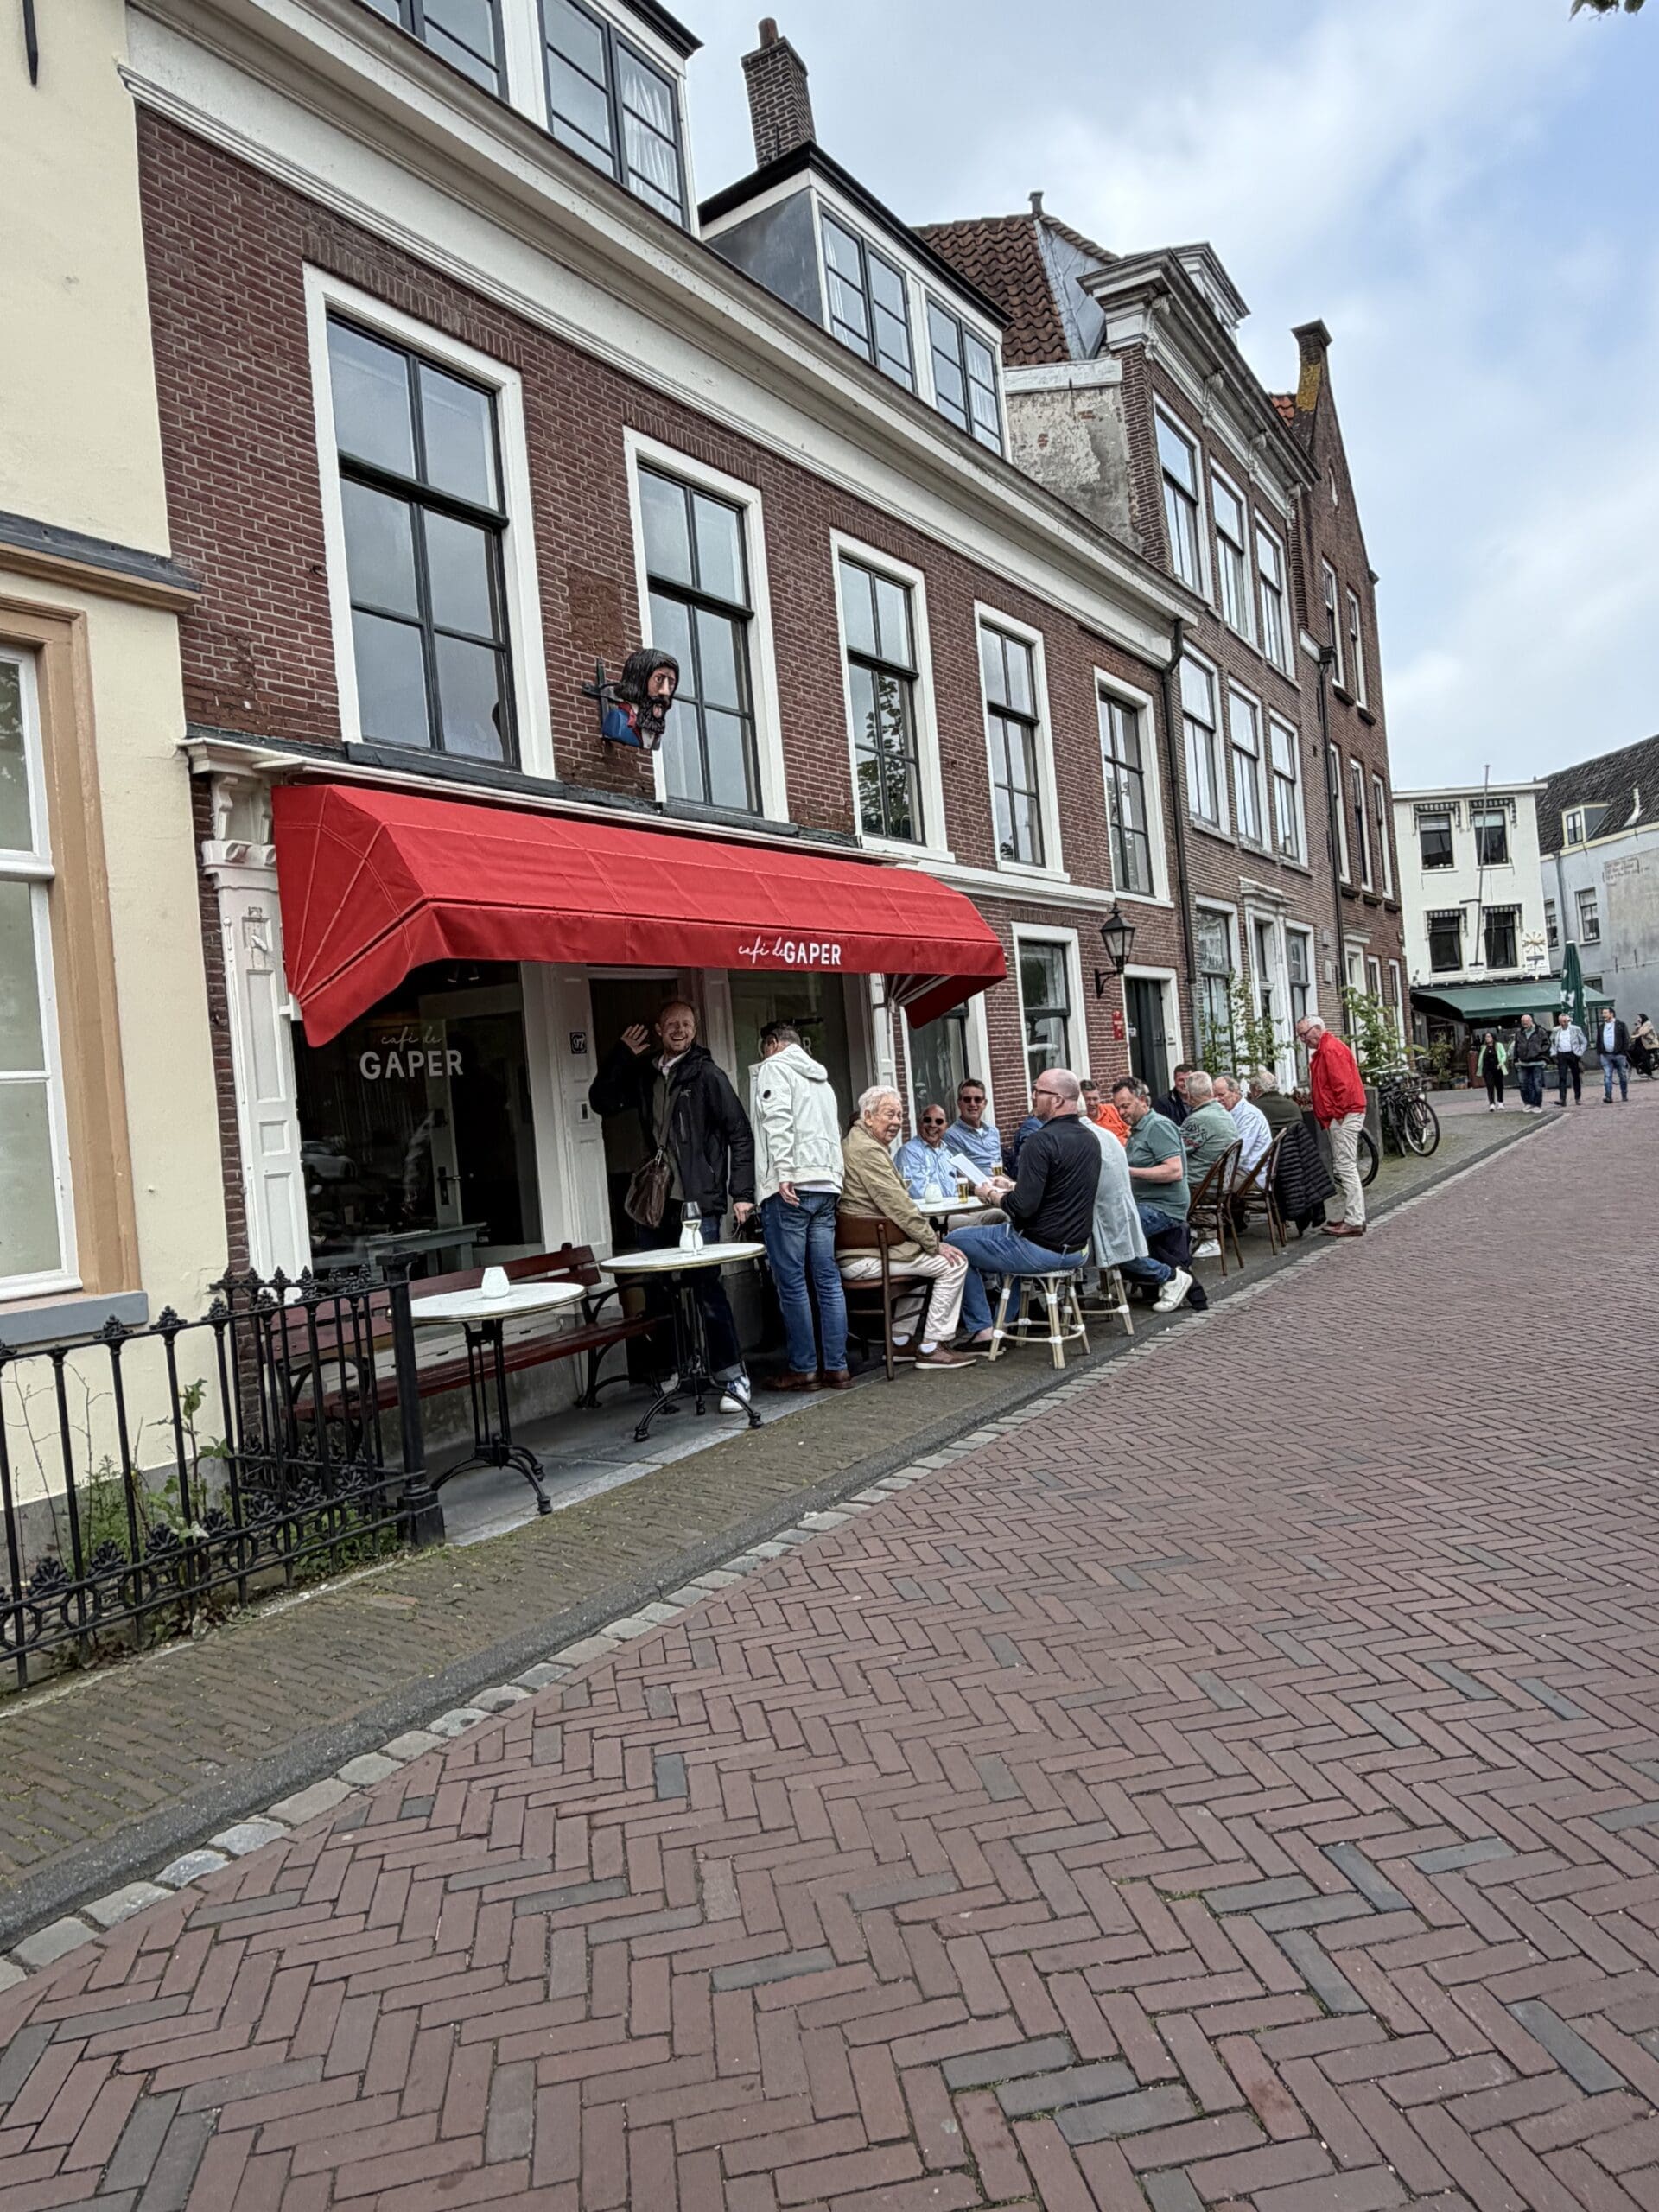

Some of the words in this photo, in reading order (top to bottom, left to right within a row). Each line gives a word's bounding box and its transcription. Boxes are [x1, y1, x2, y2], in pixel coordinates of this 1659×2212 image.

[784, 941, 841, 965] GAPER
[423, 1026, 442, 1043] de
[359, 1050, 464, 1080] GAPER
